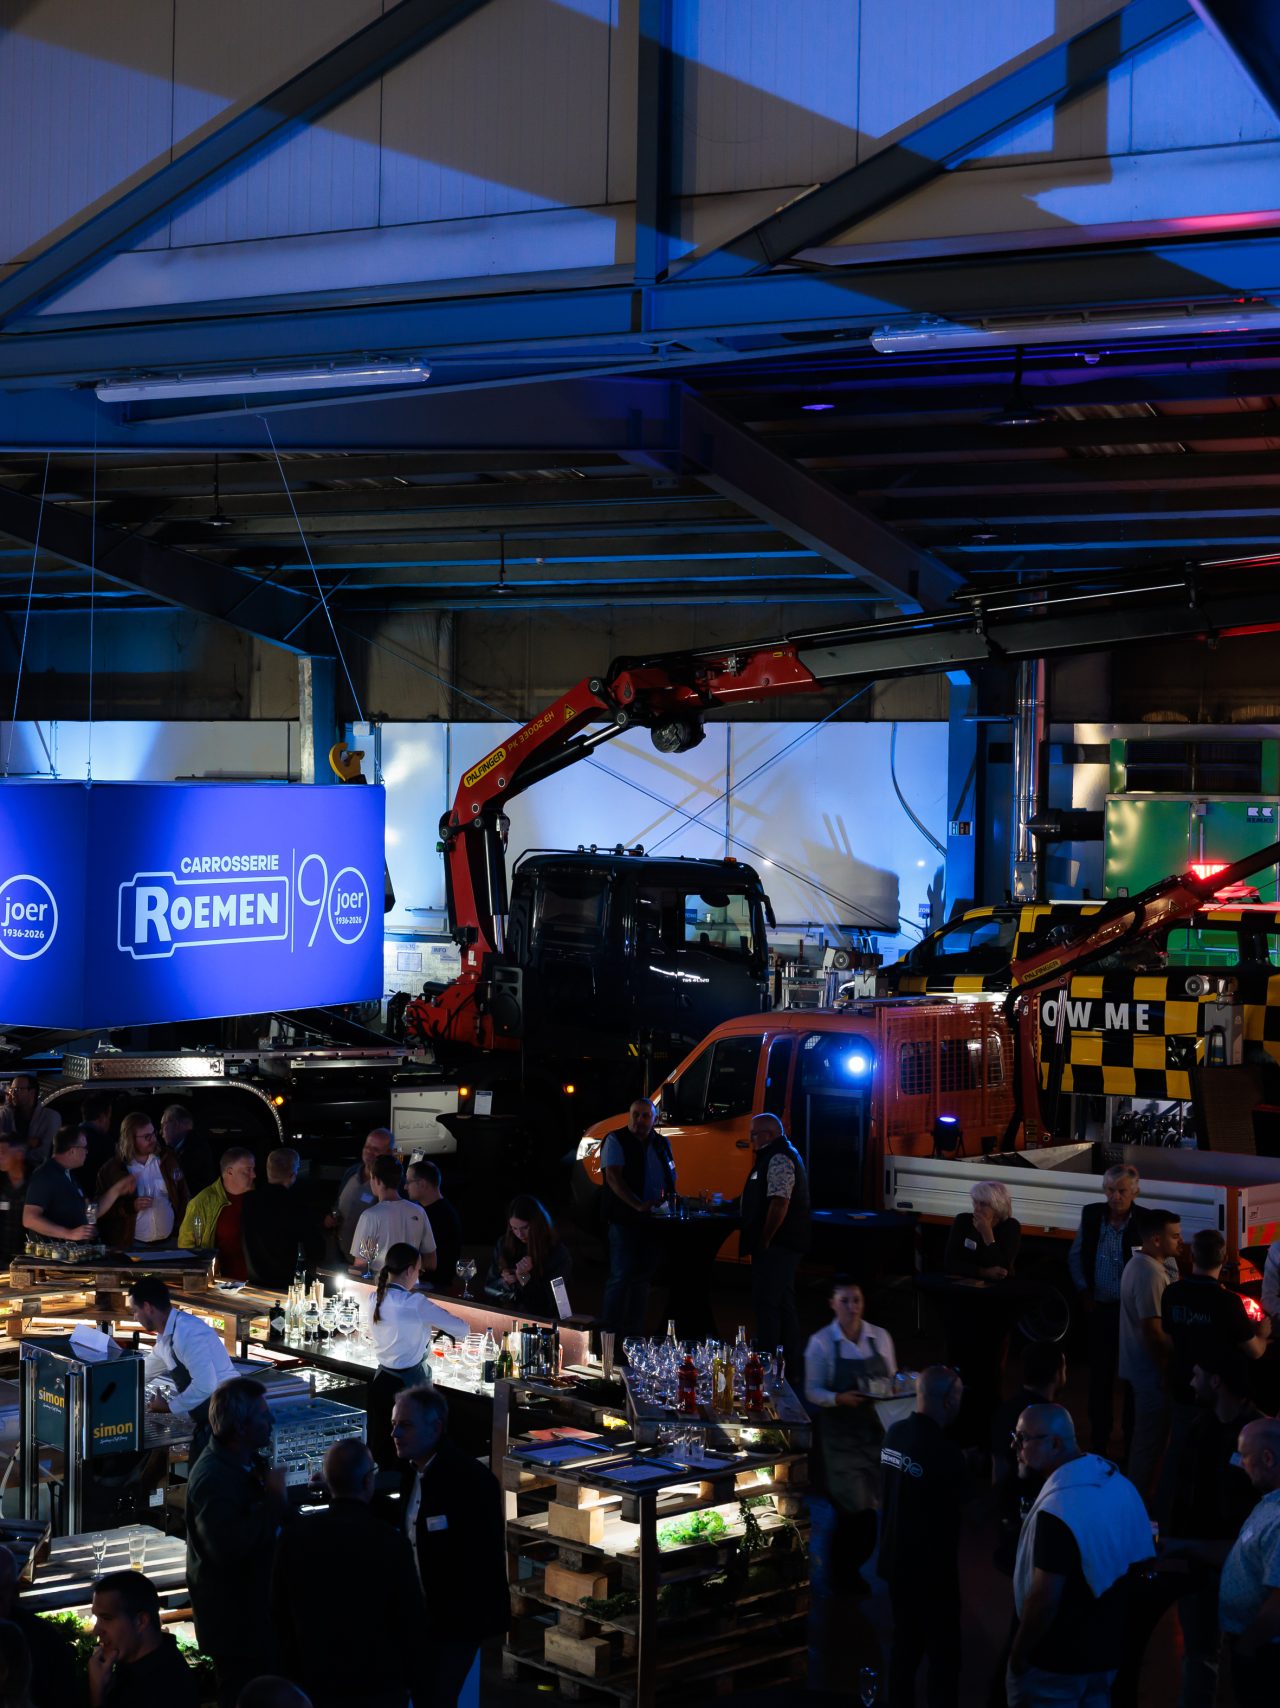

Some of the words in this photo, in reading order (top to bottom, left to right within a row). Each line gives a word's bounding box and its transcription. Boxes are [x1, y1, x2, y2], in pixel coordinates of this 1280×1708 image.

[465, 750, 505, 785] PALFINGER
[507, 740, 519, 753] PK
[180, 854, 280, 874] CARROSSERIE
[1, 896, 48, 927] joer
[297, 853, 370, 947] 90
[334, 887, 364, 916] joer
[134, 886, 279, 944] ROEMEN
[335, 915, 363, 925] 1936-2026
[2, 928, 45, 939] 1936-2026
[1023, 960, 1060, 982] PALFINGER
[1104, 1002, 1150, 1031] ME
[38, 1386, 65, 1409] simon
[93, 1422, 133, 1439] simon
